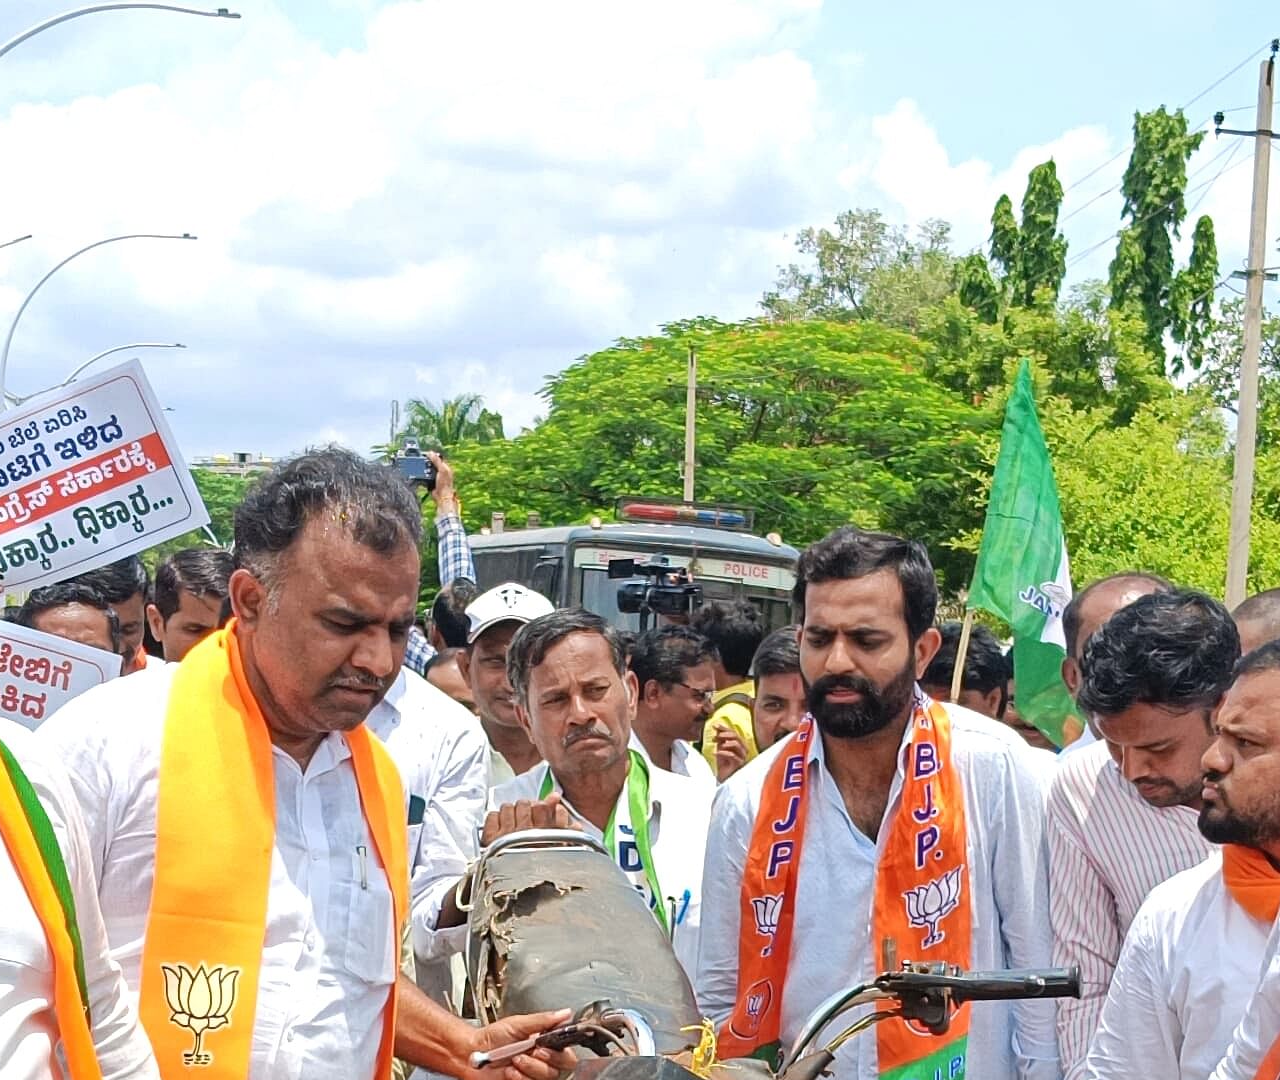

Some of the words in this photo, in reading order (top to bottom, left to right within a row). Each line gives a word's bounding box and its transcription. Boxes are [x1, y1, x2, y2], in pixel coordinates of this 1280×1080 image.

[8, 421, 40, 450] ಬೆಲೆ
[43, 405, 87, 433] ಏರಿಸಿ
[54, 415, 123, 460] ಇಳಿದ
[57, 441, 157, 497] ಸರ್ಕಾರಕ್ಕೆ
[73, 485, 174, 543] ಧಿಕ್ಕಾರ...
[724, 562, 769, 579] POLICE
